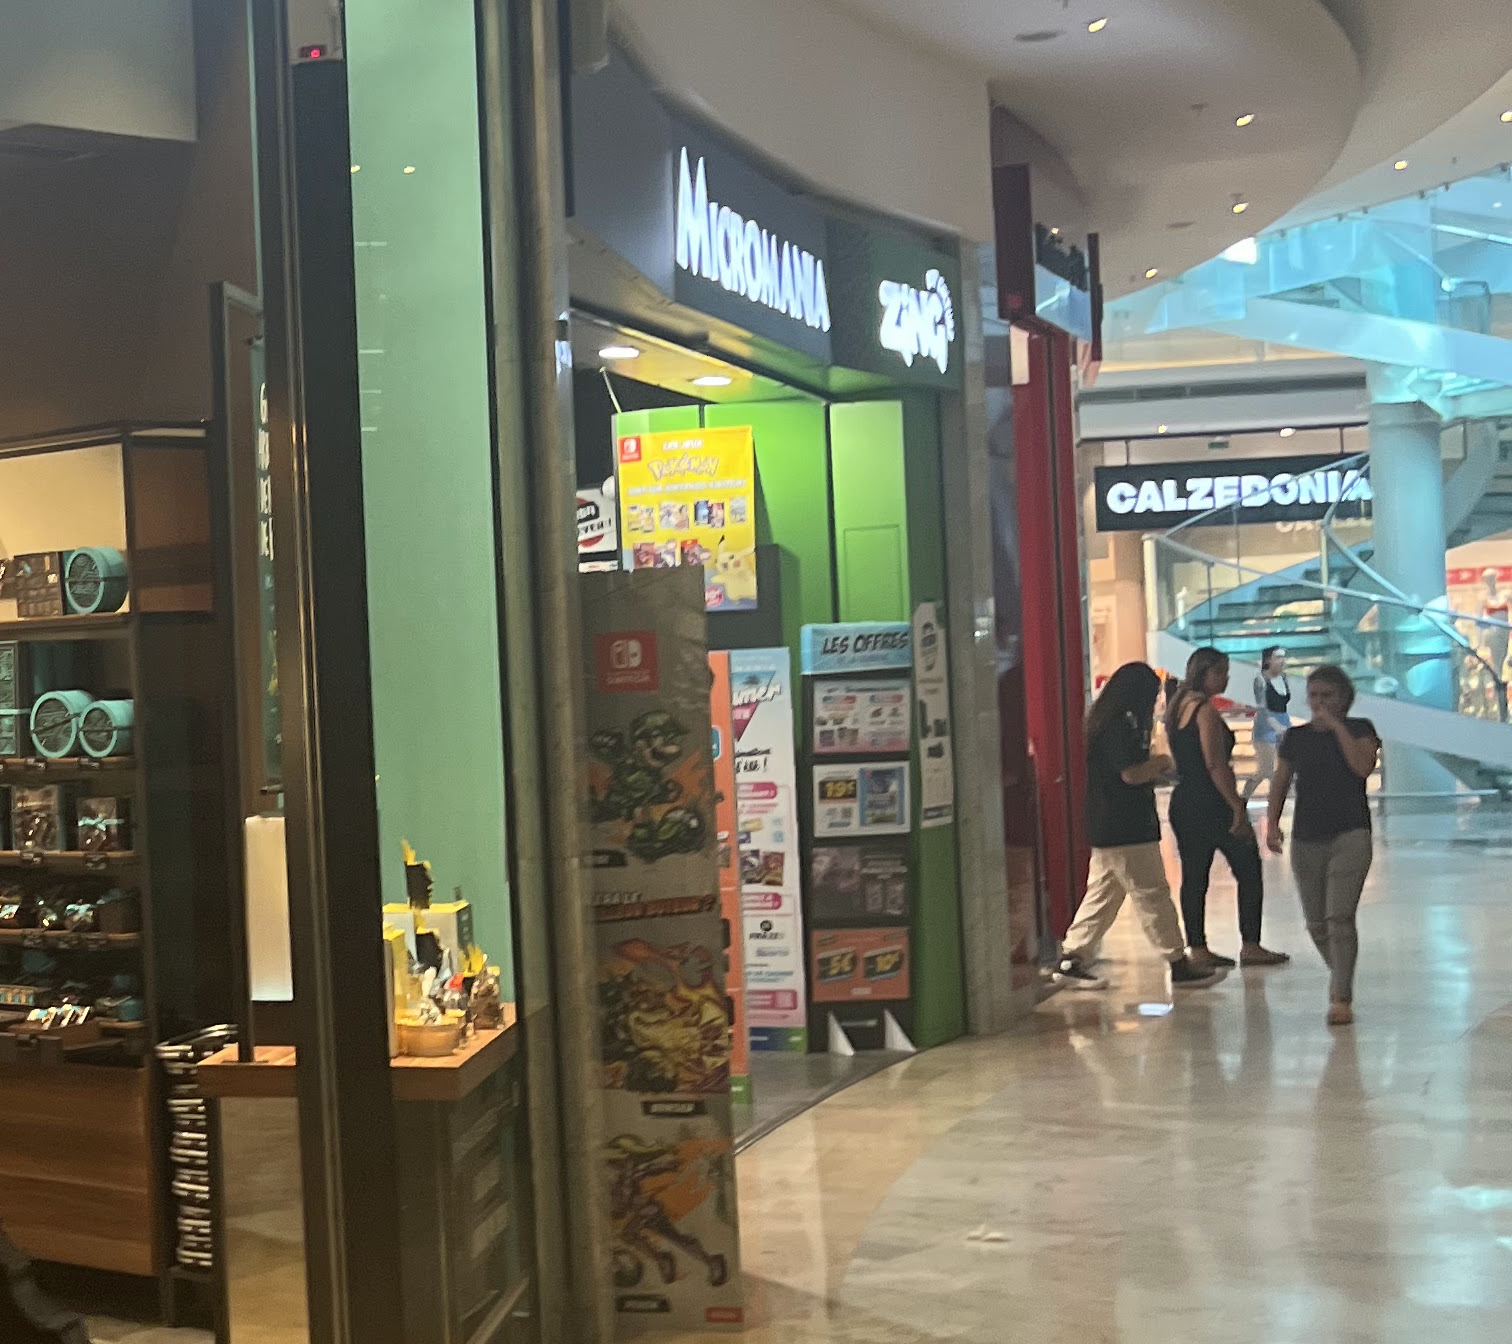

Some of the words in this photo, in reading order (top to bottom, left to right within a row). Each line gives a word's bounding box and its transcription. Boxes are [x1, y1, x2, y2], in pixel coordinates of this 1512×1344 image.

[1106, 468, 1373, 515] CALZEDONIA
[823, 635, 849, 655] LES
[853, 631, 909, 654] OFFRES
